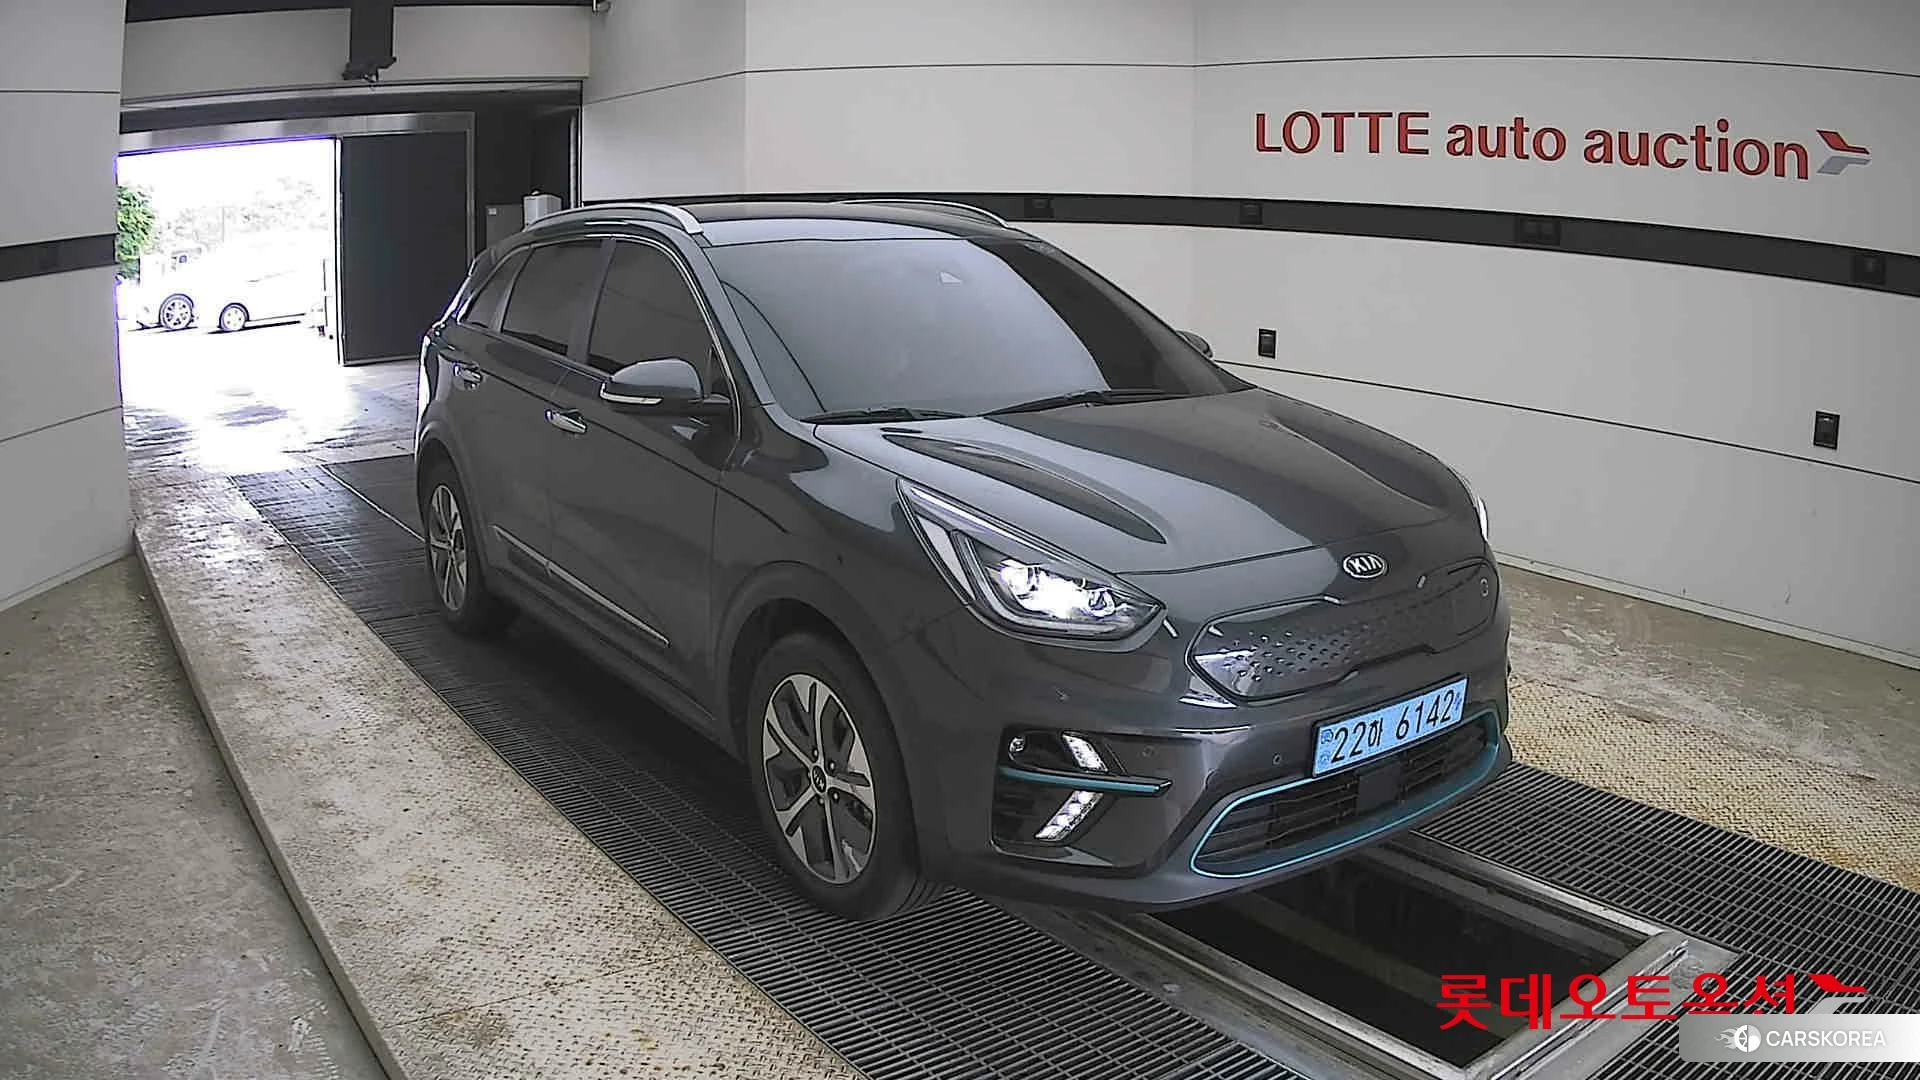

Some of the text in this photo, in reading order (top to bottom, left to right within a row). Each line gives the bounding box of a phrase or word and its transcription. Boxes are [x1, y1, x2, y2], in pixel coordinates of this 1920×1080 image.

[1255, 111, 1810, 180] LOTTE auto auction
[1348, 556, 1382, 573] KIA
[1330, 721, 1383, 763] 22하
[1396, 689, 1455, 740] 6142
